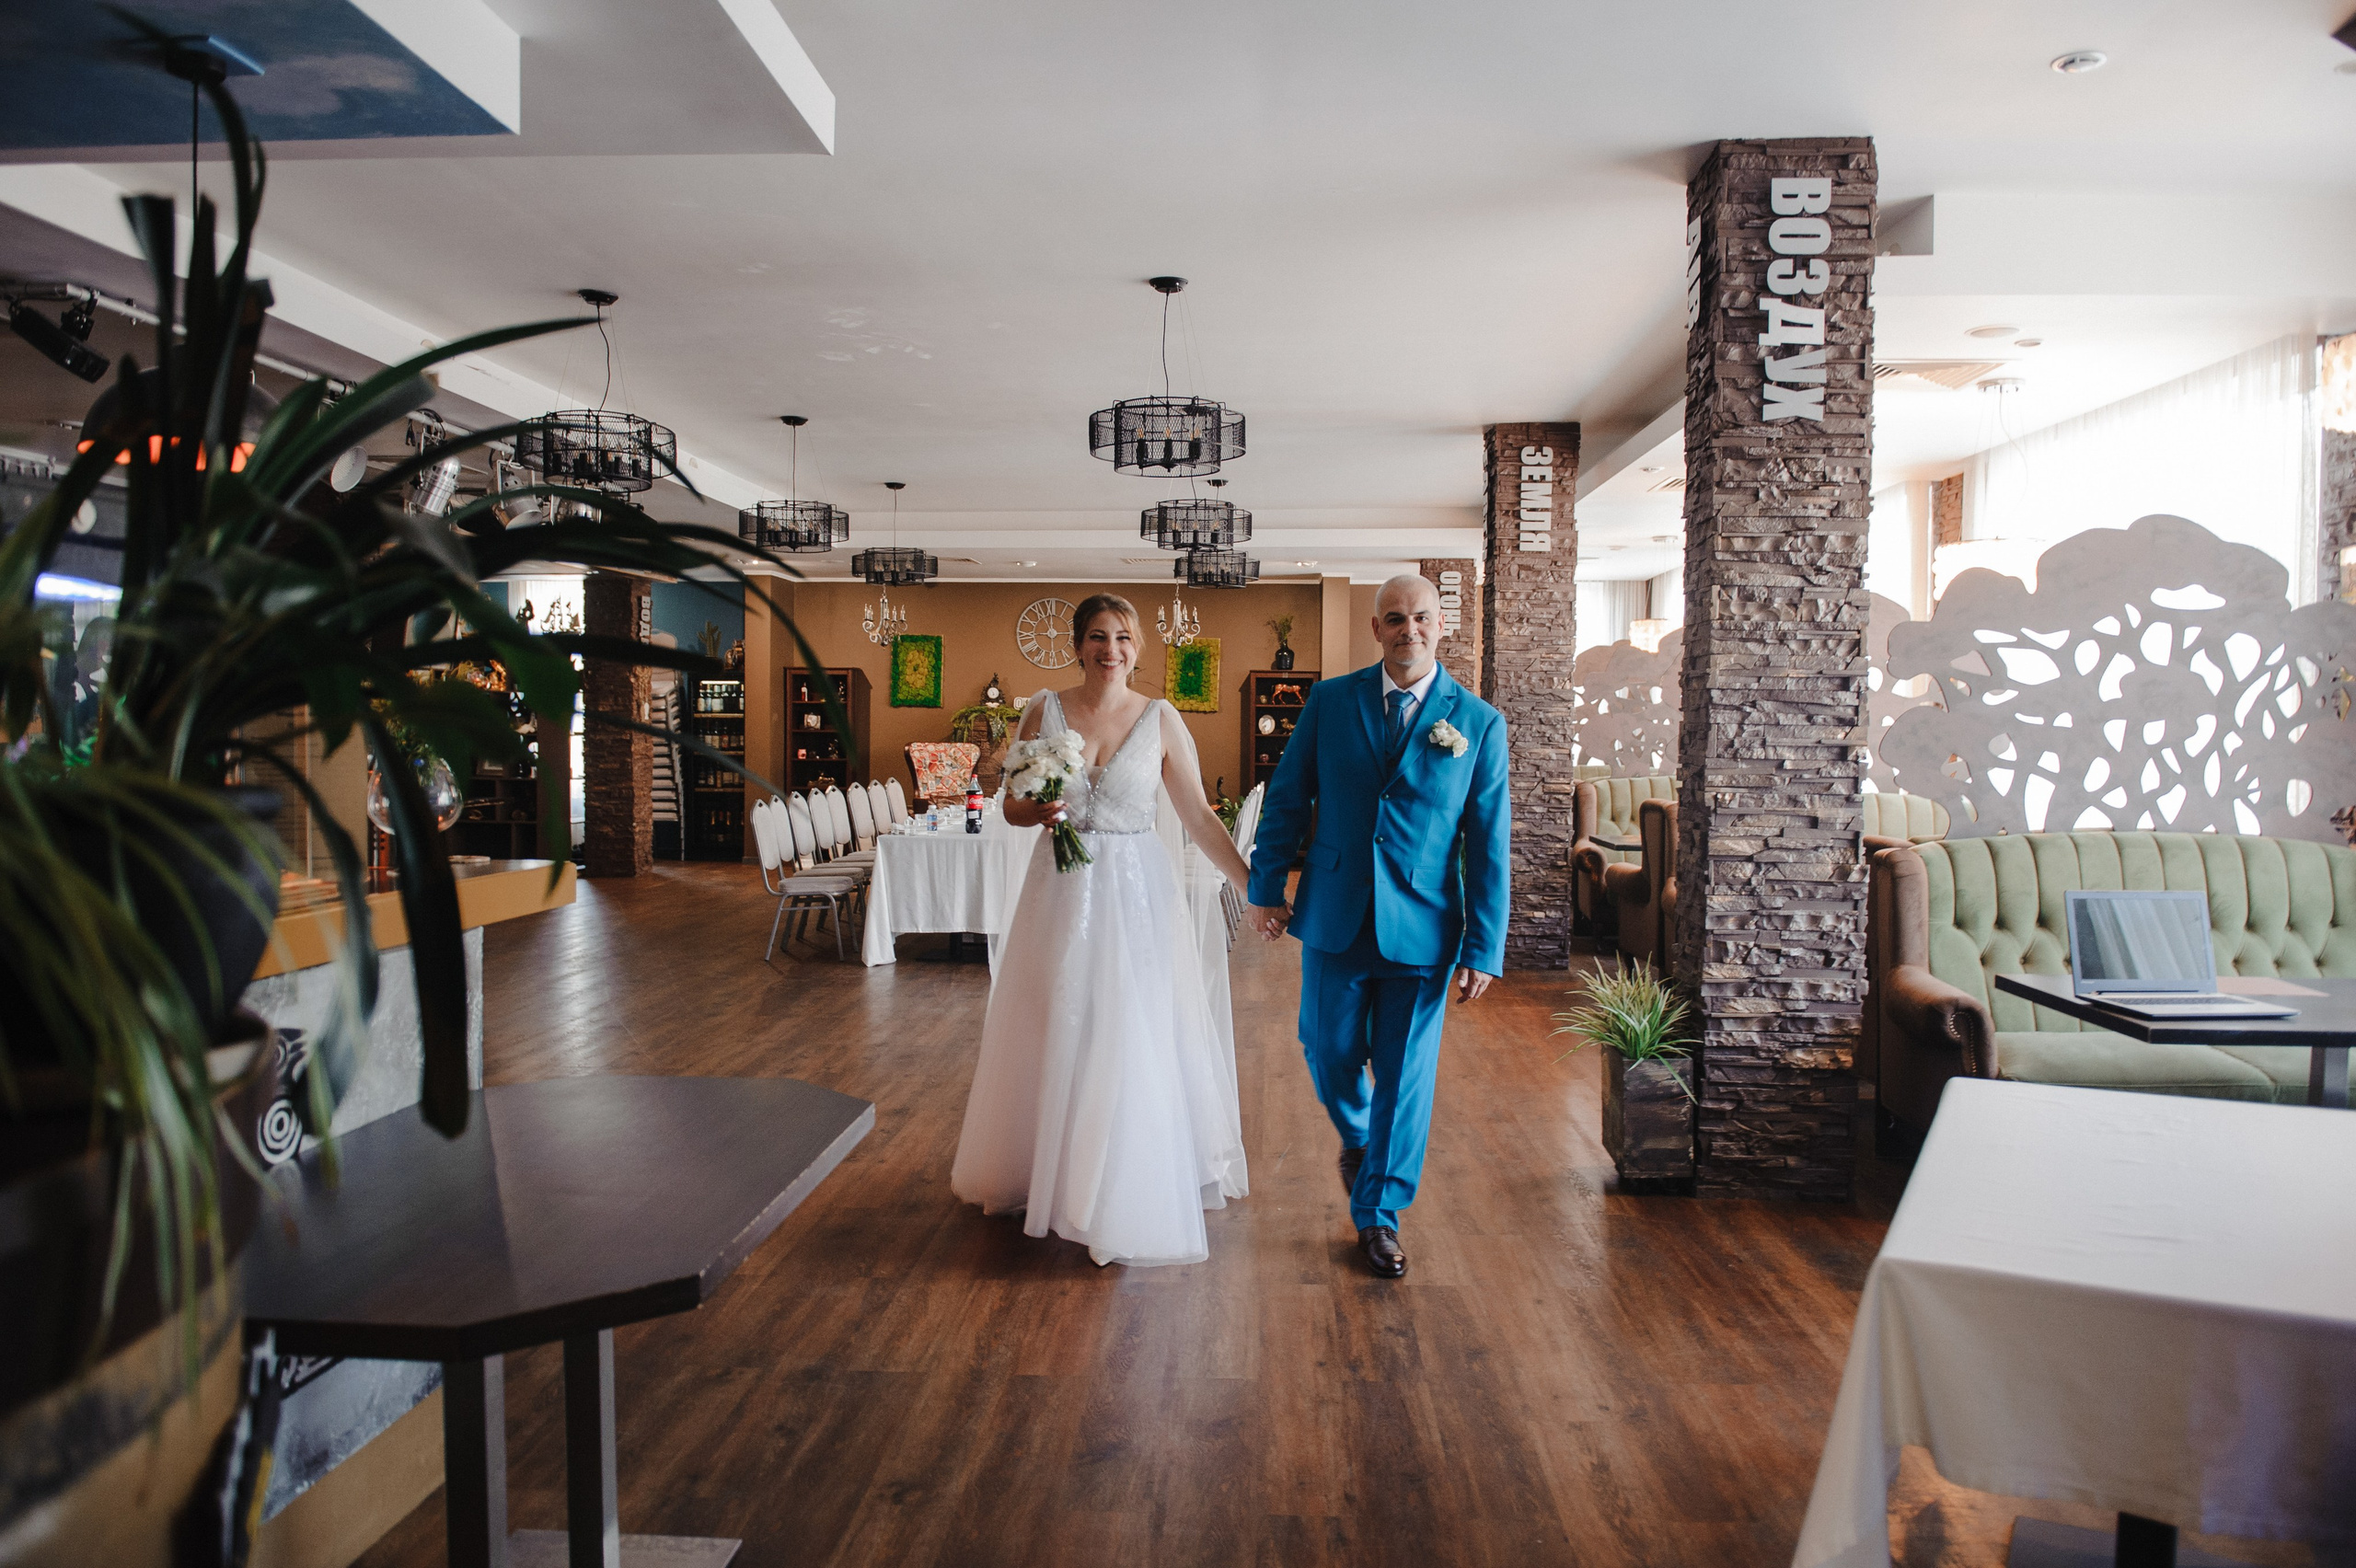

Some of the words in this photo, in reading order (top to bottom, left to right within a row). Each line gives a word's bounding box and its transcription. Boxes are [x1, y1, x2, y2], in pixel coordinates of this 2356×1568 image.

[1686, 215, 1702, 332] AIR
[1759, 178, 1832, 421] ВОЗДУХ
[1519, 445, 1554, 552] ЗЕМЛЯ
[1439, 571, 1462, 637] ОГОНЬ
